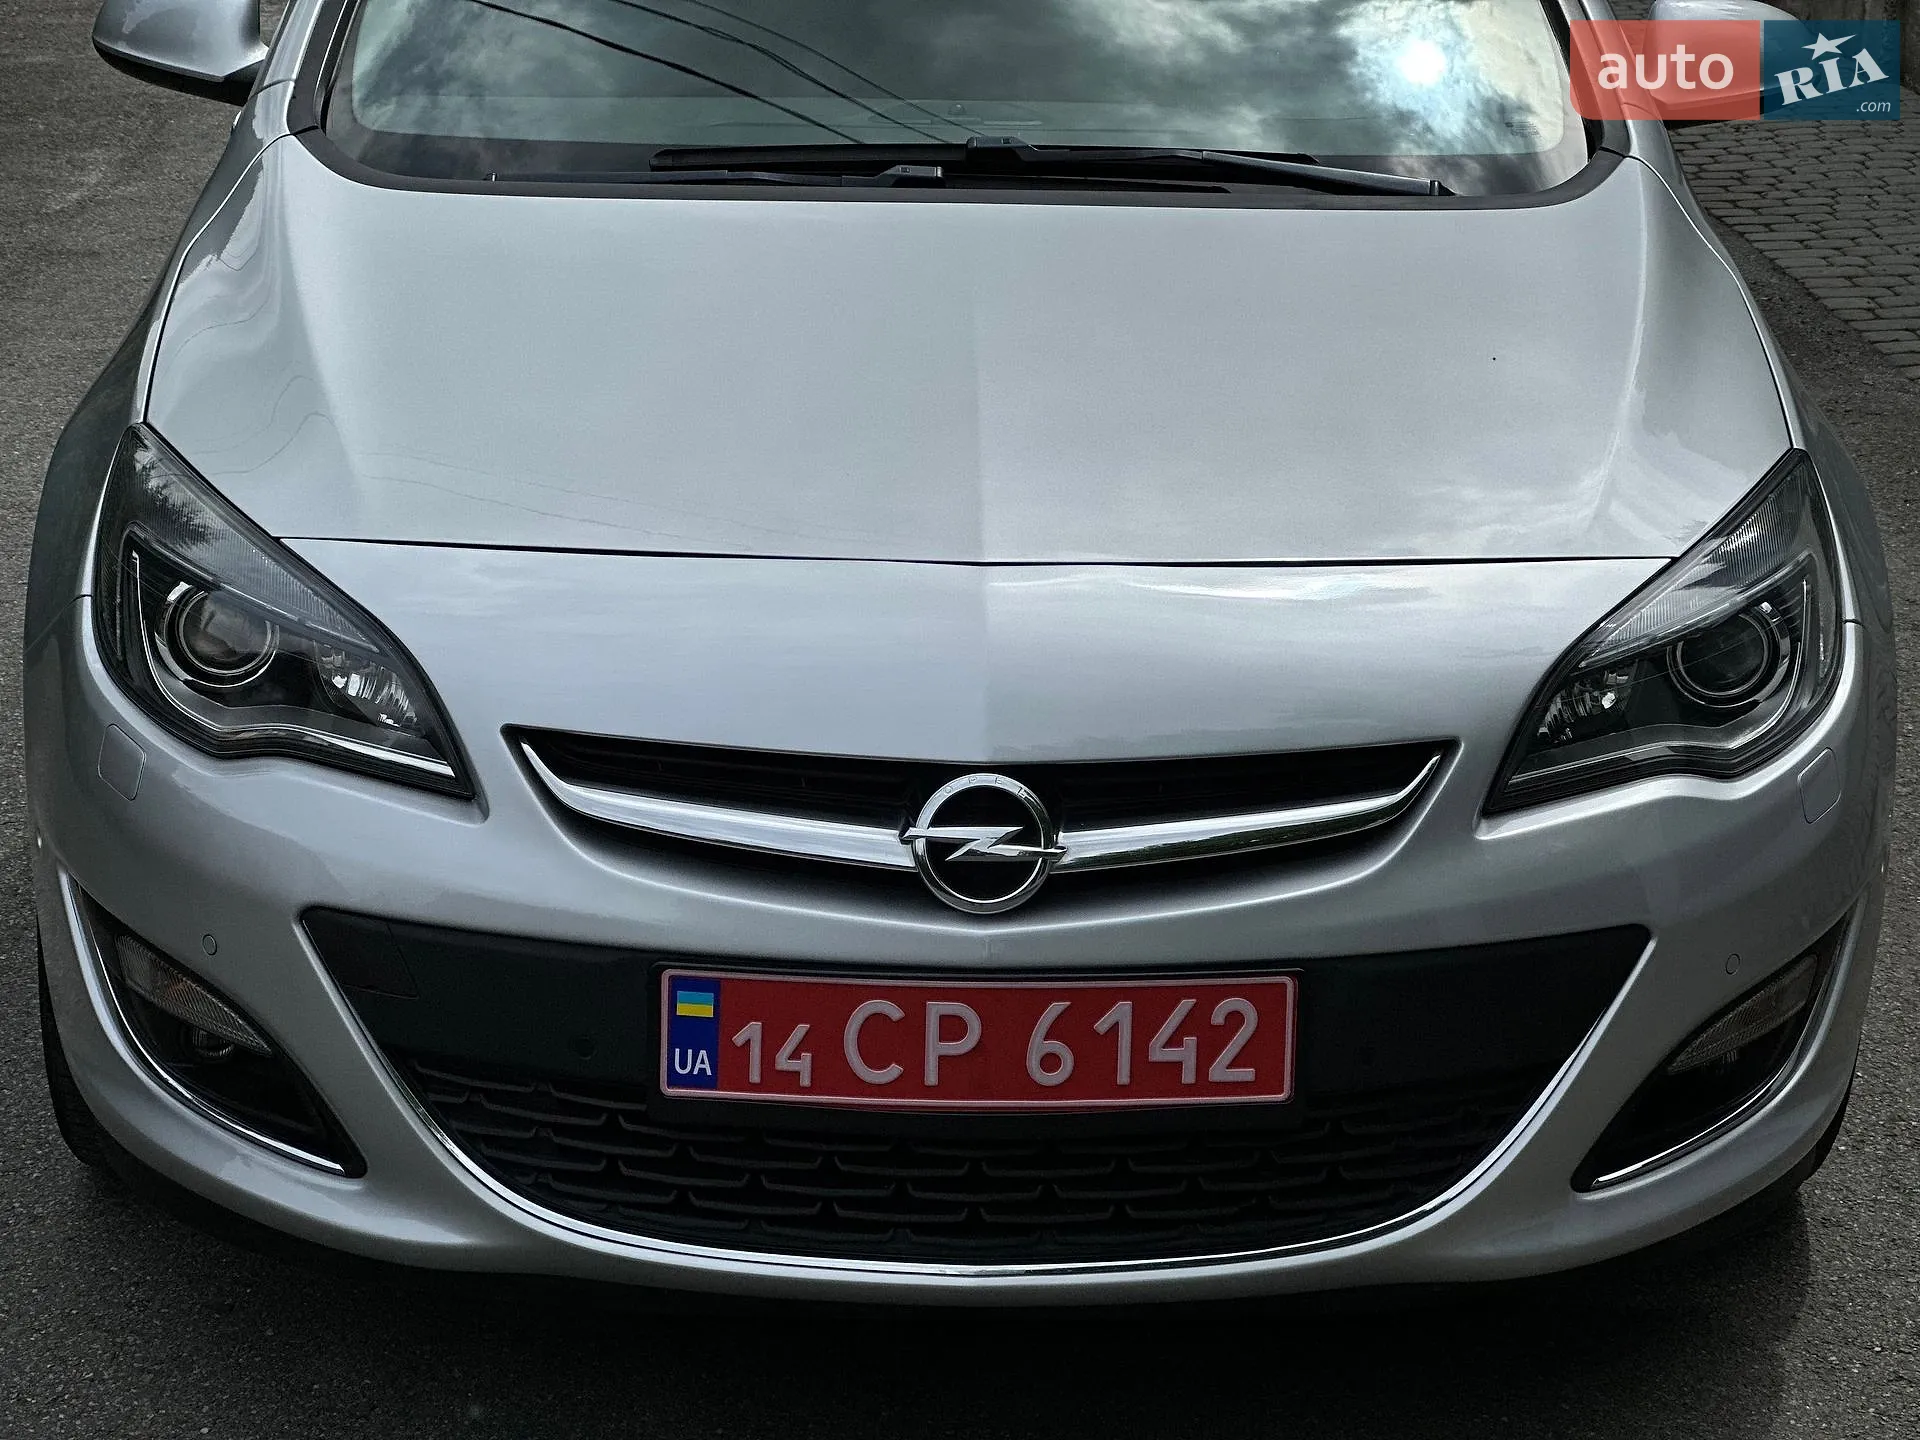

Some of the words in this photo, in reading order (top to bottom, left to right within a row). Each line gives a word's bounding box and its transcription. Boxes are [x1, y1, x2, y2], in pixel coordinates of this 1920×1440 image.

[674, 1048, 712, 1076] UA
[732, 1022, 811, 1087] 14
[844, 1000, 981, 1087] CP
[1027, 998, 1258, 1086] 6142
